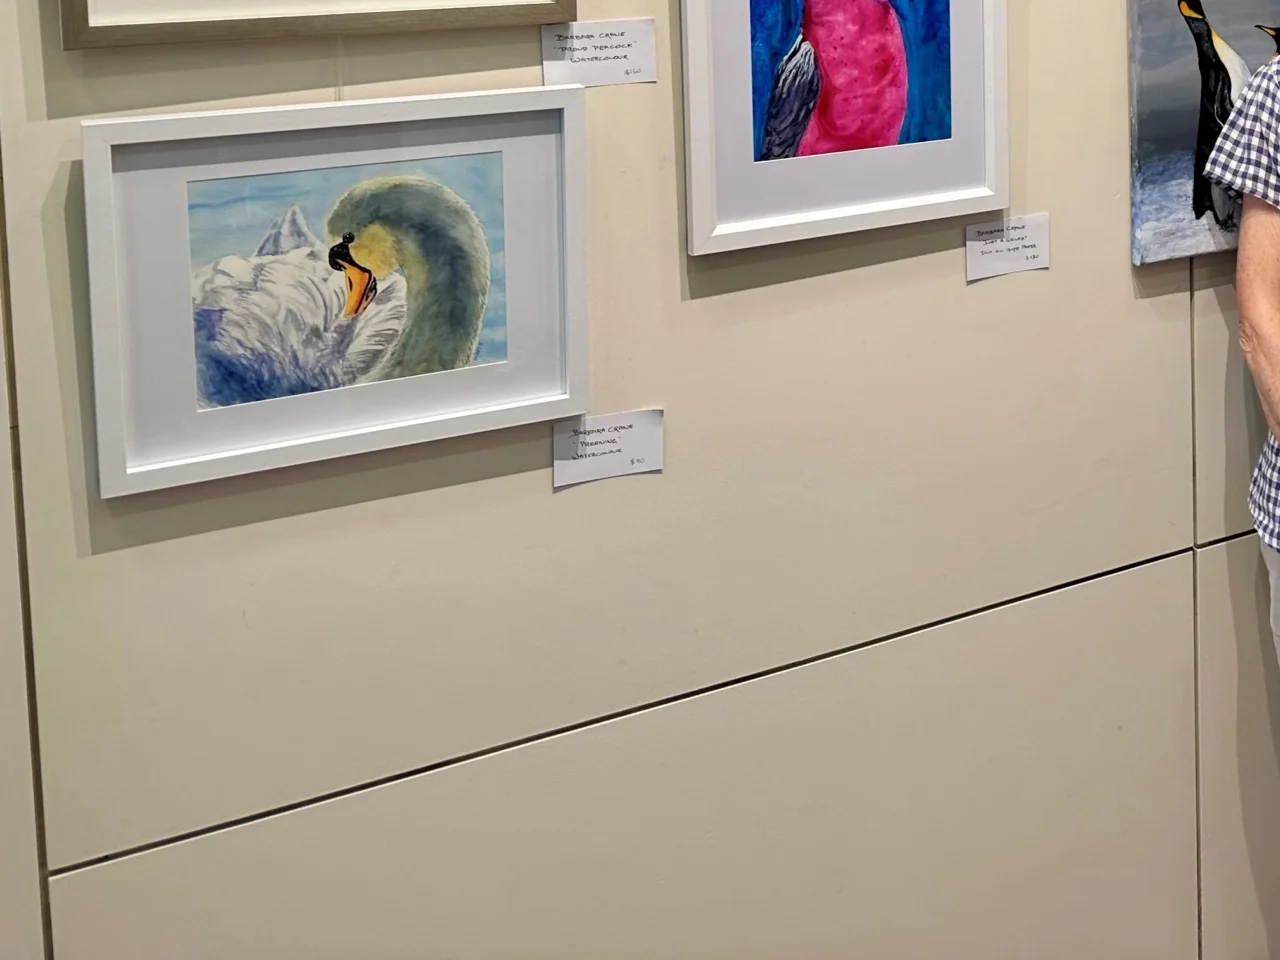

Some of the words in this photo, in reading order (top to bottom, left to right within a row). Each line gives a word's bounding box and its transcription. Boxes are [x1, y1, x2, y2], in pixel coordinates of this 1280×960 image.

[554, 33, 594, 41] BARBARA
[599, 31, 626, 40] CRANE
[570, 54, 628, 63] WATERCOLOUR
[608, 424, 634, 433] CRANE
[571, 448, 623, 460] WATERCOLOUR
